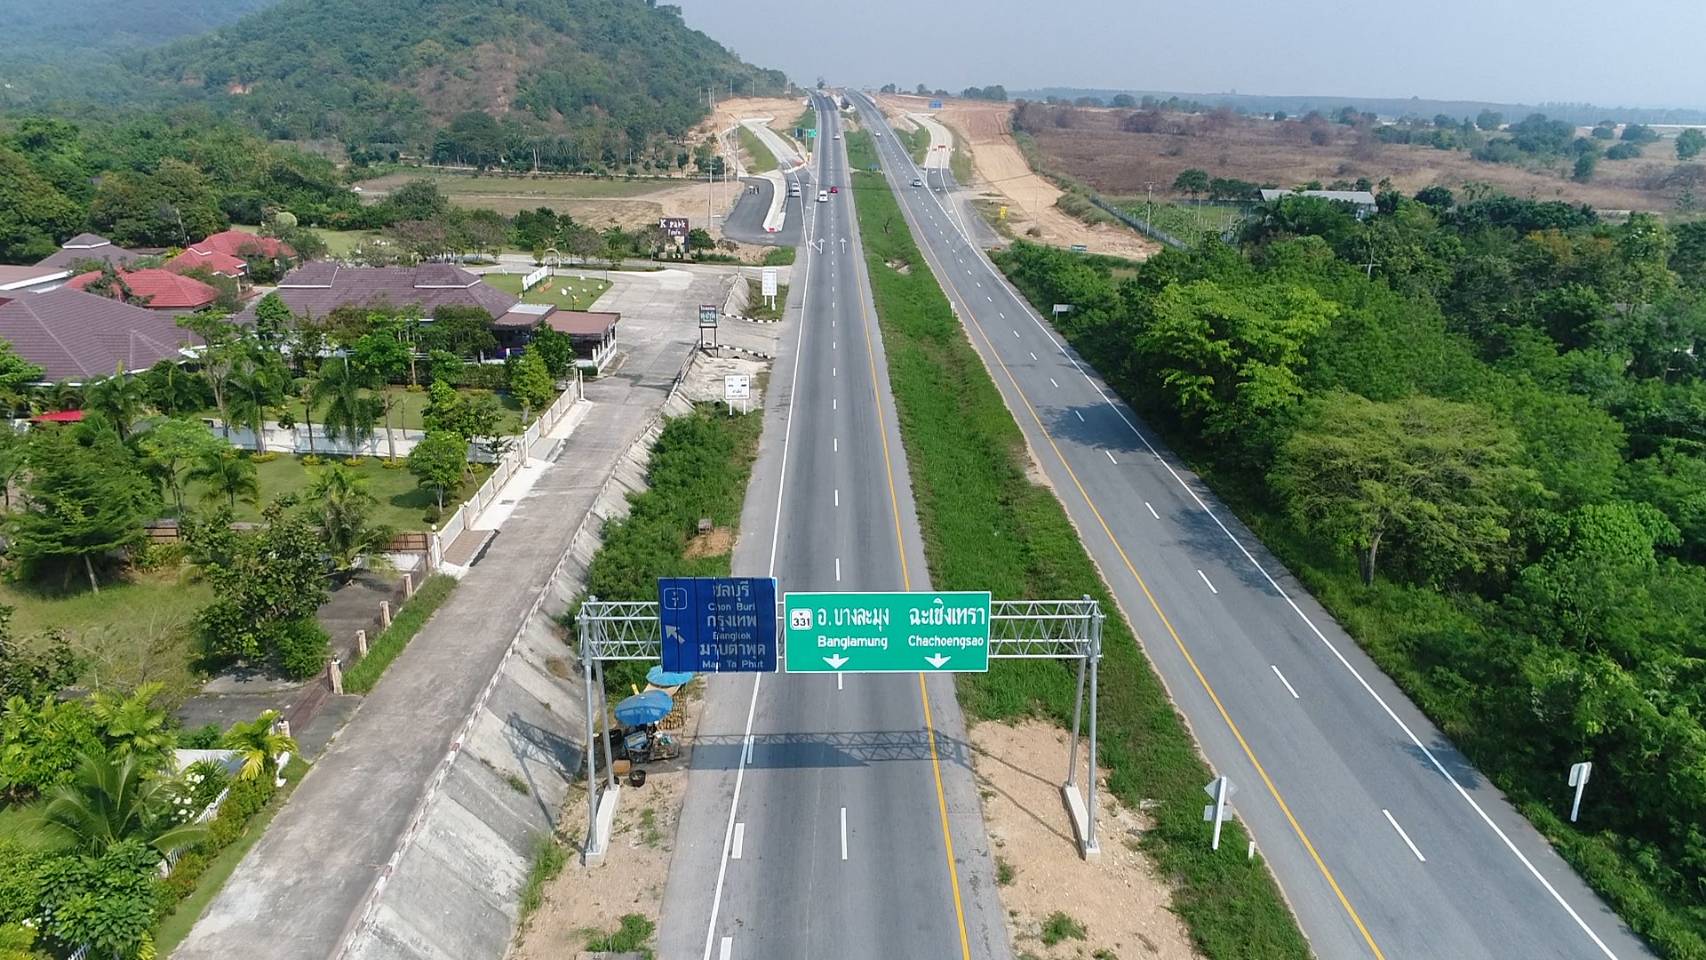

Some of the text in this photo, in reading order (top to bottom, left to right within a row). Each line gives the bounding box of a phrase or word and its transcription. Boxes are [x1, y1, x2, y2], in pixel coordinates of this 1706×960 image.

[736, 602, 756, 611] Buri
[909, 597, 985, 626] ฉะเชิงเทรา
[707, 615, 757, 632] กรุงเทพ
[793, 617, 811, 627] 331
[817, 635, 888, 650] Banglamung
[908, 635, 985, 650] Chachoengsao
